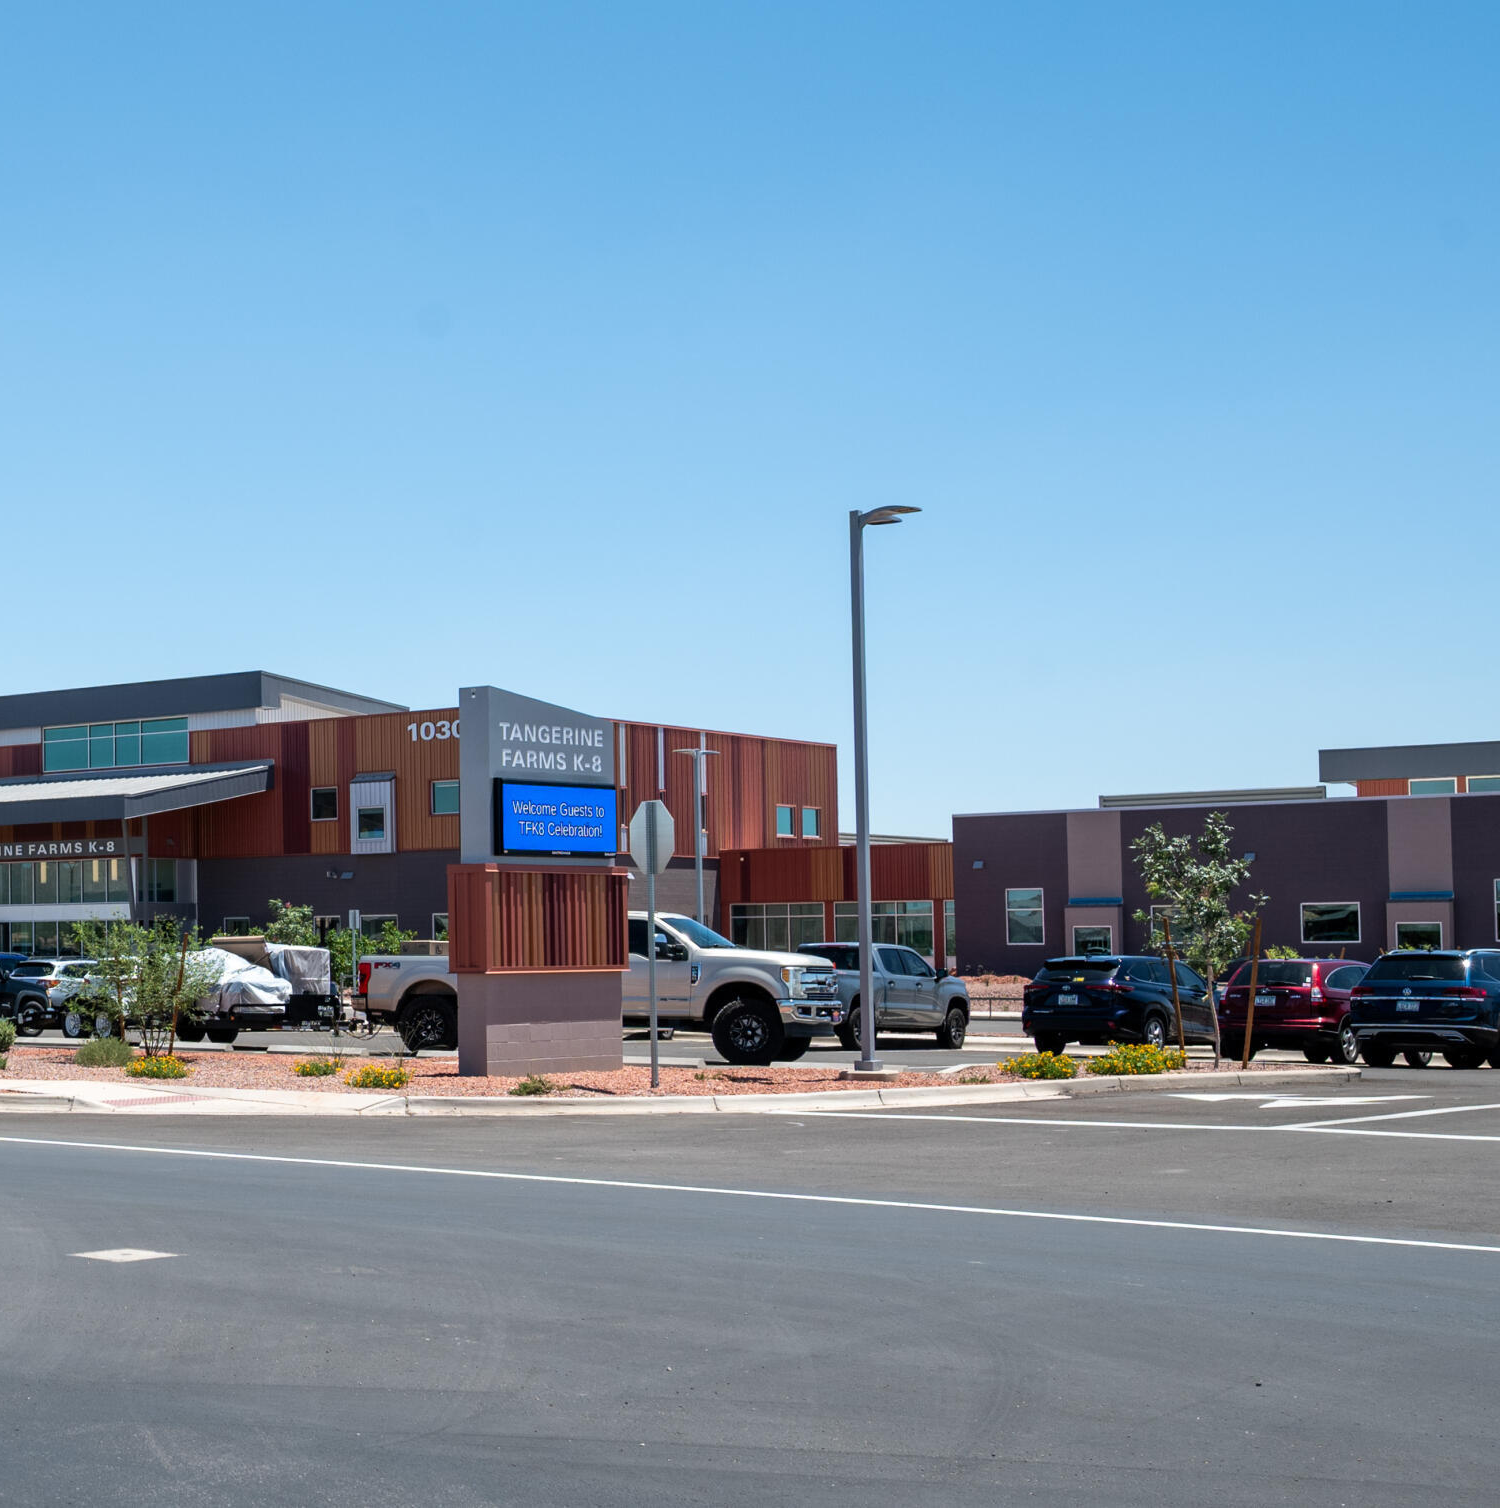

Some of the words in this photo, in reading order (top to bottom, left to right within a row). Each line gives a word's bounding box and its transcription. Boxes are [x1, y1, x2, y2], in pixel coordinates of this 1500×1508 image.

[499, 722, 604, 747] TANGERINE
[502, 748, 567, 770] FARMS
[573, 753, 602, 773] K-8
[512, 800, 557, 816] Welcome
[560, 802, 593, 817] Guests
[596, 805, 605, 818] to
[519, 820, 545, 836] TFK8
[547, 822, 603, 838] Celebration!
[28, 842, 83, 856] FARMS
[89, 841, 116, 853] K-8
